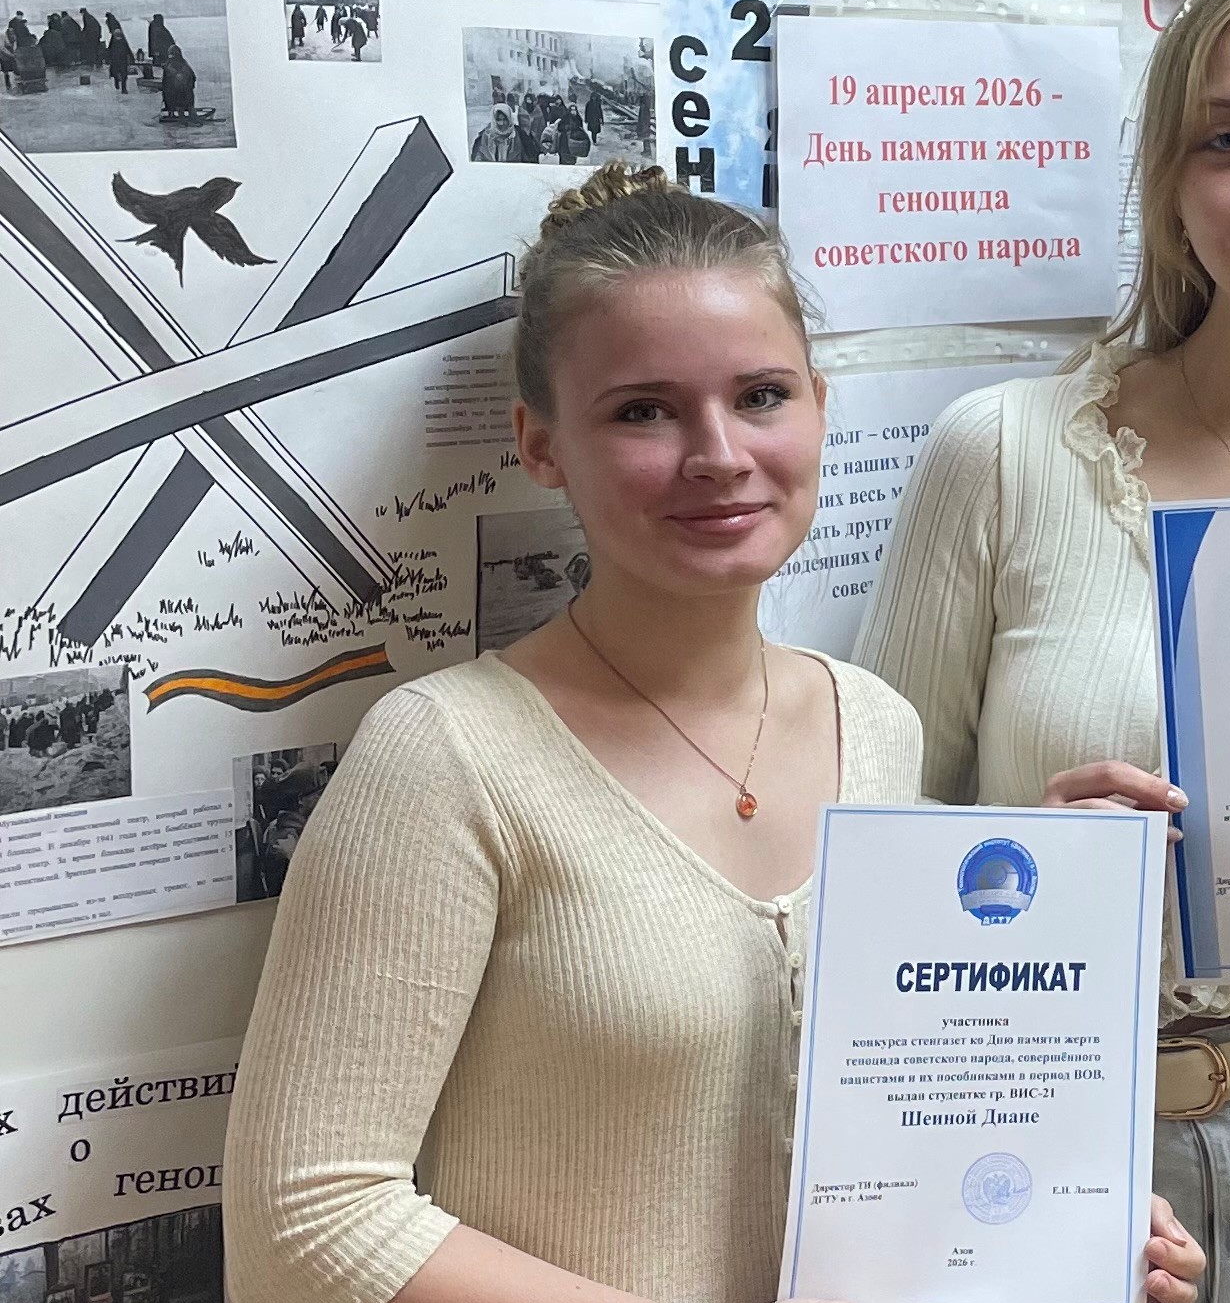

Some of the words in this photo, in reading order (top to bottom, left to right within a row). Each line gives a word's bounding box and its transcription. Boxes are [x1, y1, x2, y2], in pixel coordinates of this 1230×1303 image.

[828, 75, 856, 105] 19
[866, 84, 965, 114] апреля
[974, 77, 1041, 106] 2026
[802, 132, 872, 170] День
[880, 140, 987, 161] памяти
[996, 140, 1090, 168] жертв
[878, 190, 1010, 213] геноцида
[814, 241, 968, 267] советского
[977, 237, 1081, 266] народа
[825, 430, 863, 449] долг
[882, 423, 930, 442] сохра
[844, 456, 900, 475] наших
[849, 488, 886, 505] весь
[896, 961, 1086, 992] СЕРТИФИКАТ
[941, 1017, 1009, 1029] участника
[852, 1038, 907, 1049] конкурса
[910, 1037, 967, 1046] стенгазет
[986, 1033, 1013, 1046] Дню
[1016, 1036, 1061, 1044] памяти
[1064, 1036, 1100, 1046] жертв
[845, 1057, 899, 1066] геноцида
[903, 1055, 967, 1064] советского
[970, 1054, 1014, 1065] народа,
[1017, 1051, 1101, 1064] совершённого
[840, 1075, 905, 1084] нацистами
[908, 1074, 915, 1082] и
[919, 1074, 933, 1082] их
[936, 1070, 1015, 1081] пособниками
[1018, 1072, 1025, 1080] в
[1029, 1072, 1070, 1082] период
[1074, 1068, 1105, 1080] ВОВ,
[887, 1092, 925, 1101] выдан
[928, 1091, 986, 1102] студентке
[989, 1090, 1005, 1101] гр.
[1009, 1087, 1054, 1098] ВИС-21
[980, 1108, 1039, 1126] Диане
[947, 1258, 968, 1267] 2026
